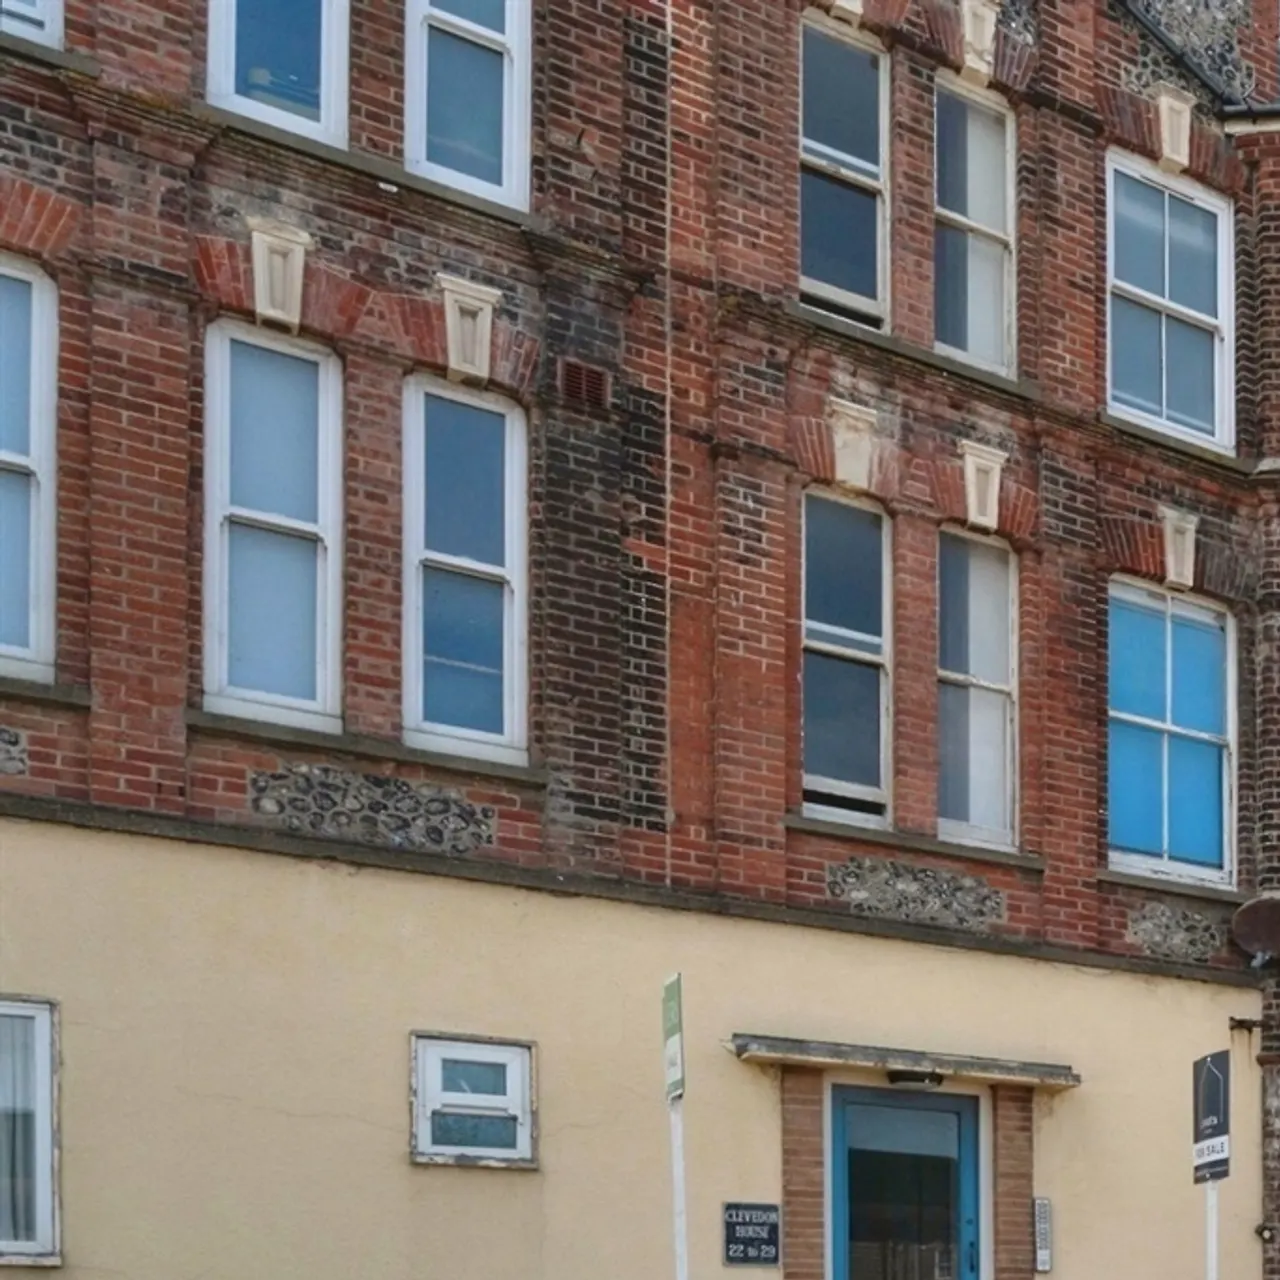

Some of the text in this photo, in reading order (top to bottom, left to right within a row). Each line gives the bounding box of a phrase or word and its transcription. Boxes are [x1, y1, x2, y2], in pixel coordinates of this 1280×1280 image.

[1206, 1141, 1225, 1157] SALE
[725, 1210, 778, 1223] CLEVEDON
[735, 1225, 769, 1238] HOUSE
[728, 1244, 744, 1257] 22
